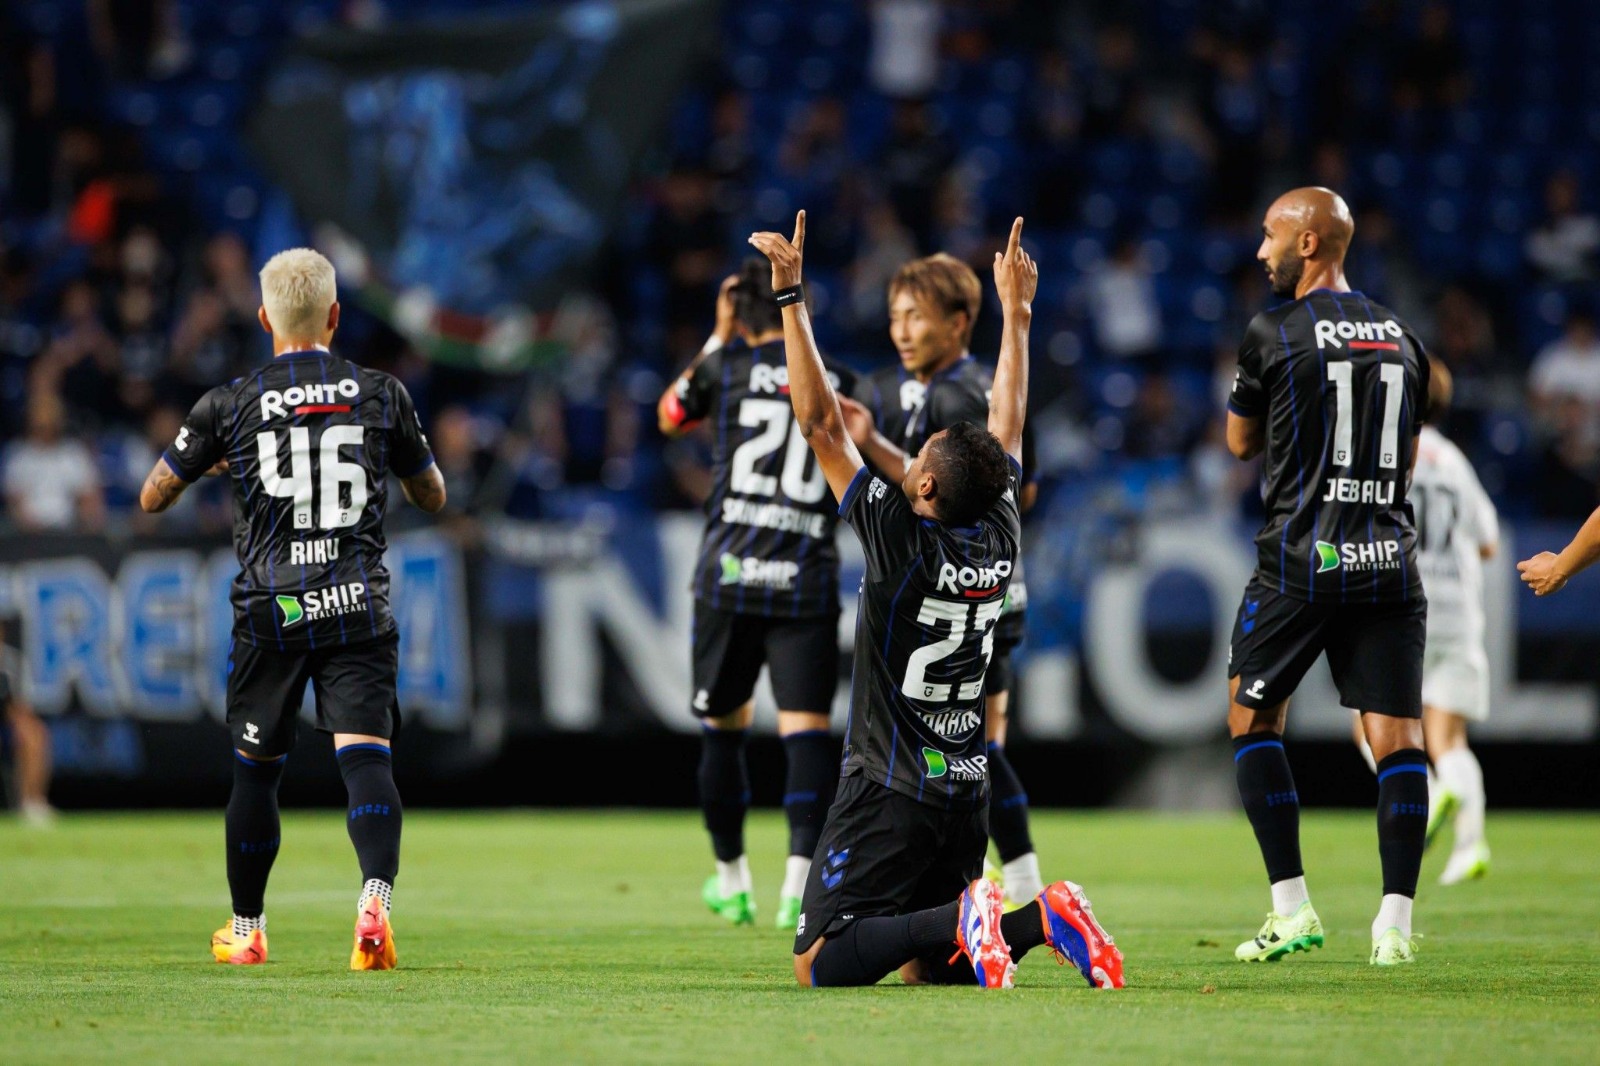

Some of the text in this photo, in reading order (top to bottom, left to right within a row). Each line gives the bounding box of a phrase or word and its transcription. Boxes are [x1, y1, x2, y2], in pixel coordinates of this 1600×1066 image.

[1315, 319, 1403, 349] ROHTO
[260, 378, 360, 421] ROHTO
[1327, 361, 1404, 469] 11
[730, 398, 827, 504] 20
[256, 425, 368, 530] 46
[1323, 478, 1395, 504] JEBALI
[290, 538, 340, 566] RIKU
[1341, 540, 1399, 565] SHIP
[1343, 561, 1401, 572] HEALTHCARE
[935, 560, 1011, 595] ROHTO
[303, 582, 366, 613] SHIP
[307, 602, 368, 621] HEALTHCARE
[901, 596, 1004, 702] 23
